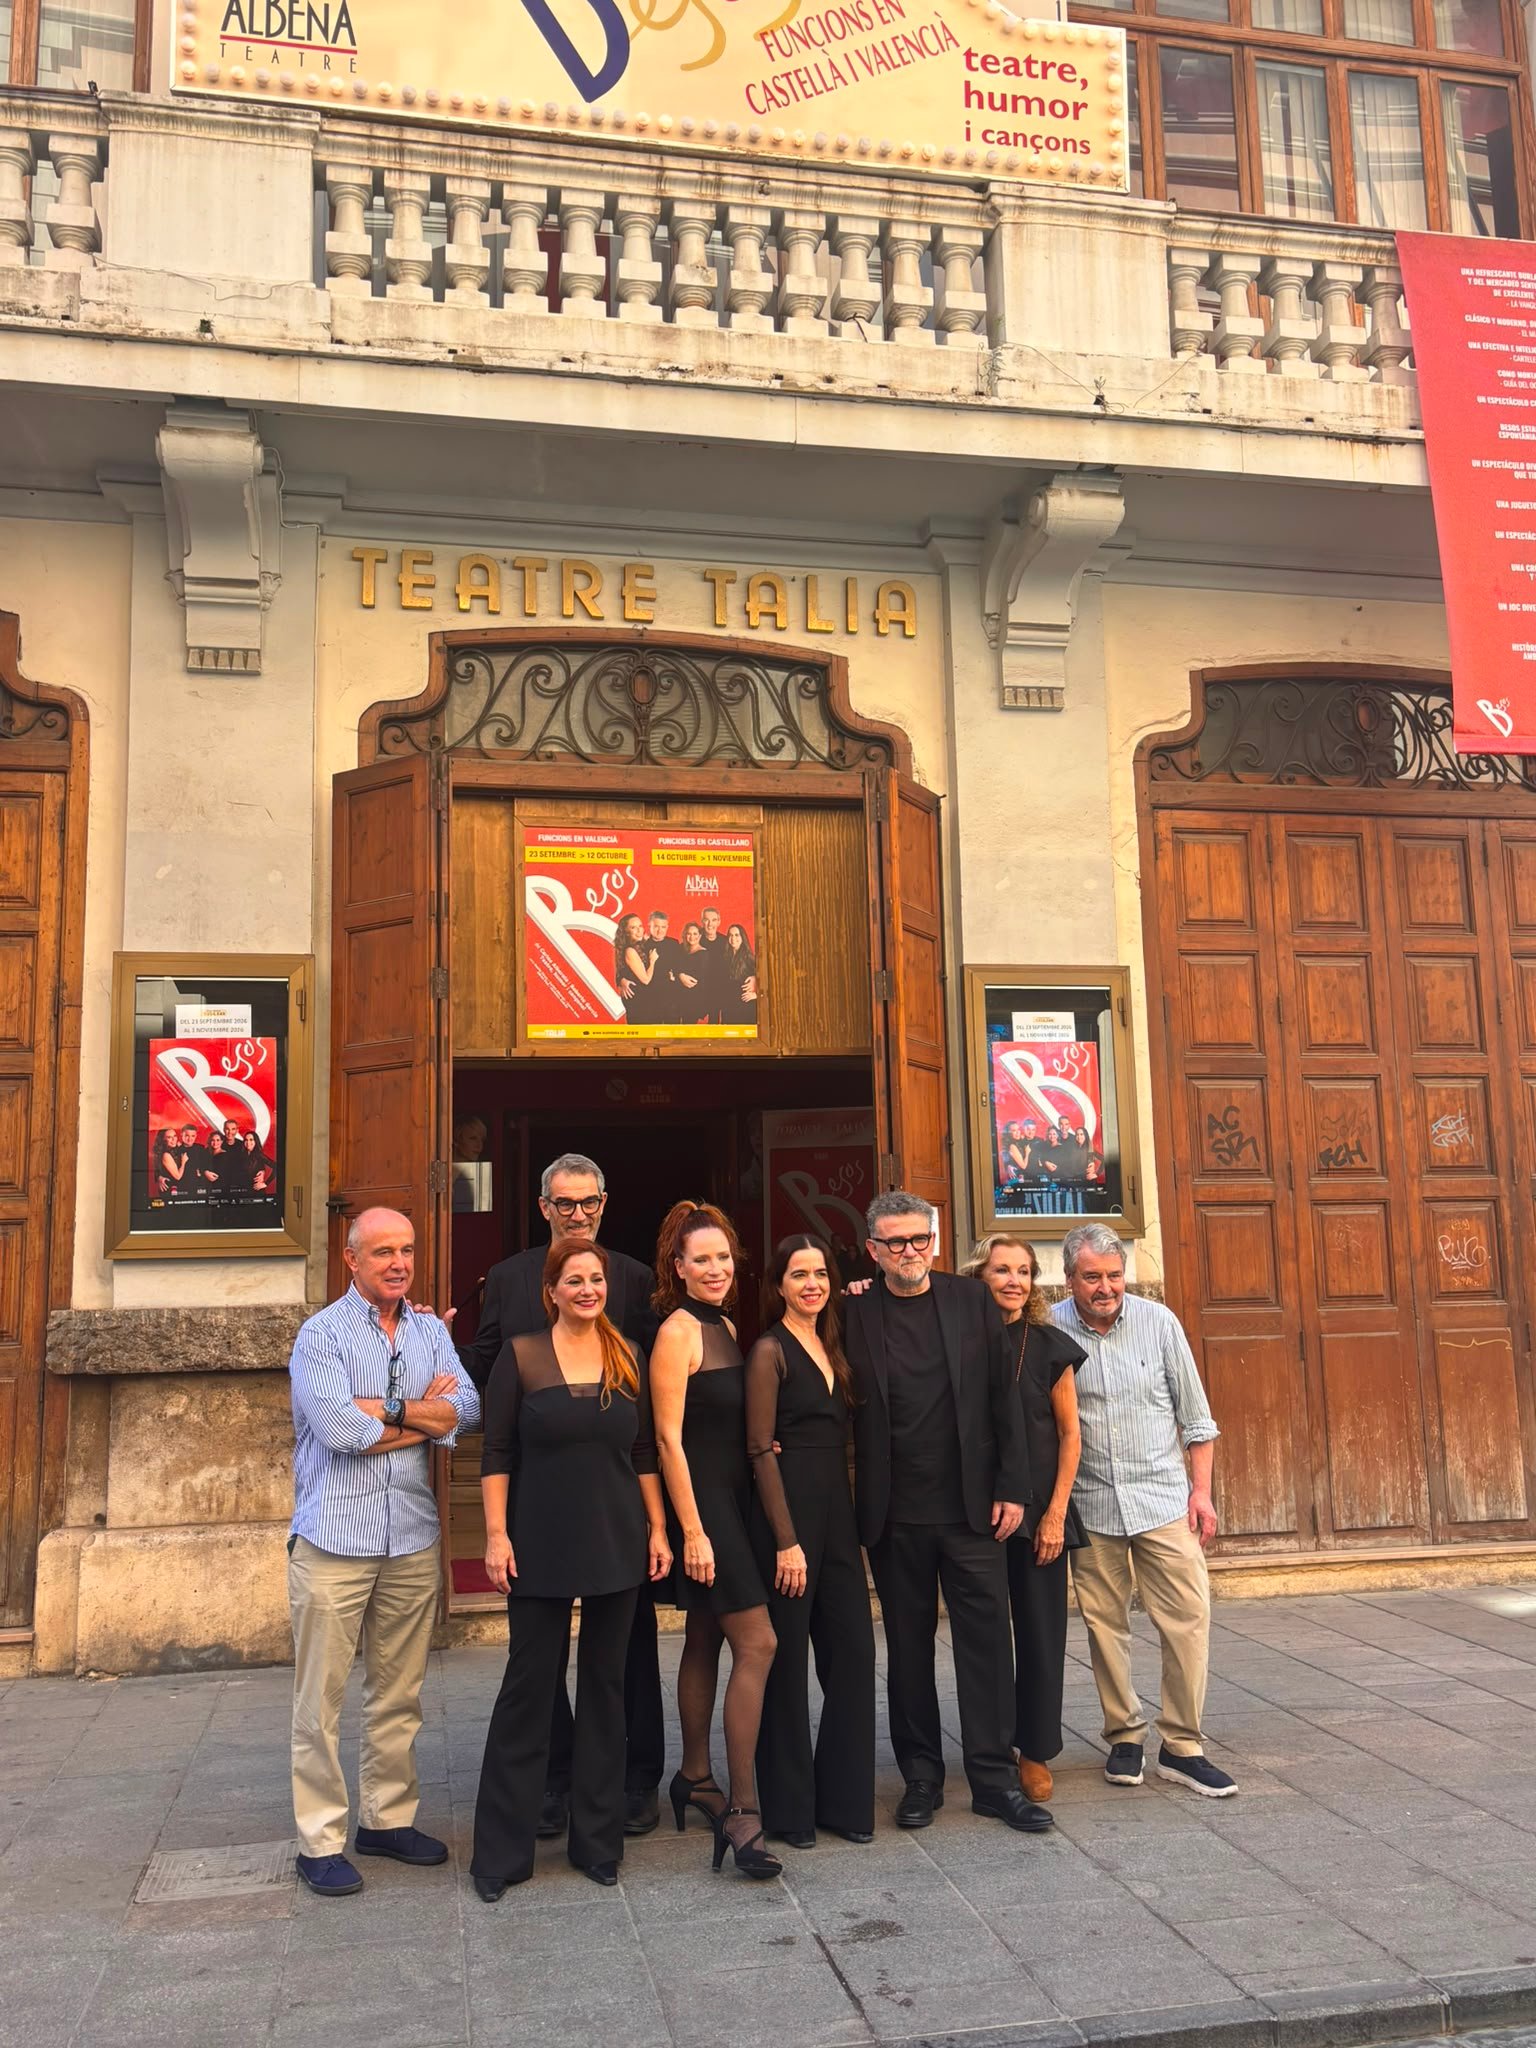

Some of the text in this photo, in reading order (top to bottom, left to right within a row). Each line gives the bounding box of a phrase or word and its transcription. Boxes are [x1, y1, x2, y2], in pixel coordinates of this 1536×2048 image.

[220, 0, 357, 46] ALBENA
[759, 0, 874, 62] FUNCIONS
[220, 43, 357, 73] TEATRE
[745, 49, 849, 115] CASTELLÀ
[843, 53, 860, 82] I
[855, 11, 961, 77] VALENCIÀ
[963, 47, 1088, 91] teatre,
[964, 80, 1089, 121] humor
[965, 120, 1091, 155] i cançons
[1461, 268, 1474, 276] UNA
[1473, 278, 1485, 286] DEL
[351, 547, 918, 638] TEATRE TALIA
[538, 833, 618, 843] FUNCIONS EN VALENCIÀ
[658, 837, 750, 847] FUNCIONES EN CASTELLANO
[529, 850, 538, 858] 23
[539, 850, 576, 859] SETEMBRE
[596, 852, 628, 860] OCTUBRE
[656, 853, 665, 861] 14
[666, 853, 697, 861] OCTUBRE
[712, 855, 751, 863] NOVIEMBRE
[685, 874, 719, 889] ALBENA
